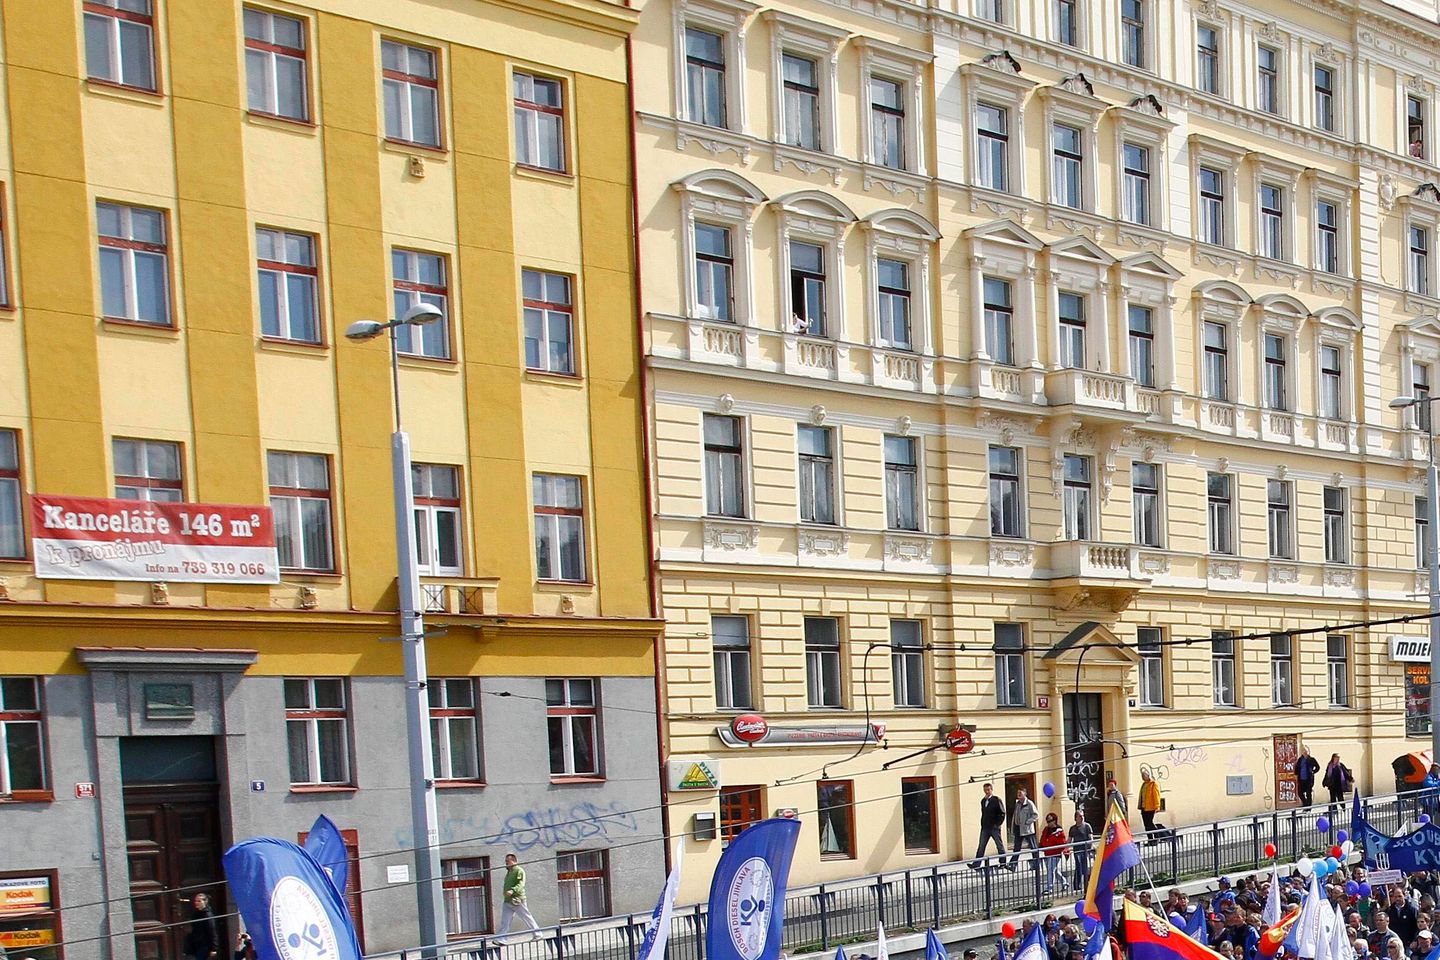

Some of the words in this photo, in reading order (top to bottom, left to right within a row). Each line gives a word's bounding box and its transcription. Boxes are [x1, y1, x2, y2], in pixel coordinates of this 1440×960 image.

[42, 505, 171, 534] Kanceláře
[179, 512, 223, 537] 146
[47, 545, 64, 565] k
[68, 539, 166, 567] pronájmu
[145, 563, 165, 573] Info
[167, 565, 179, 574] na
[211, 562, 236, 574] 319
[240, 562, 265, 575] 066
[255, 782, 262, 790] 5
[700, 762, 719, 786] PIZZA
[733, 866, 752, 896] JIHLAVA
[6, 890, 34, 899] Kodak
[731, 895, 740, 922] DIESEL
[14, 931, 41, 939] Kodak
[731, 921, 748, 954] BOSCH
